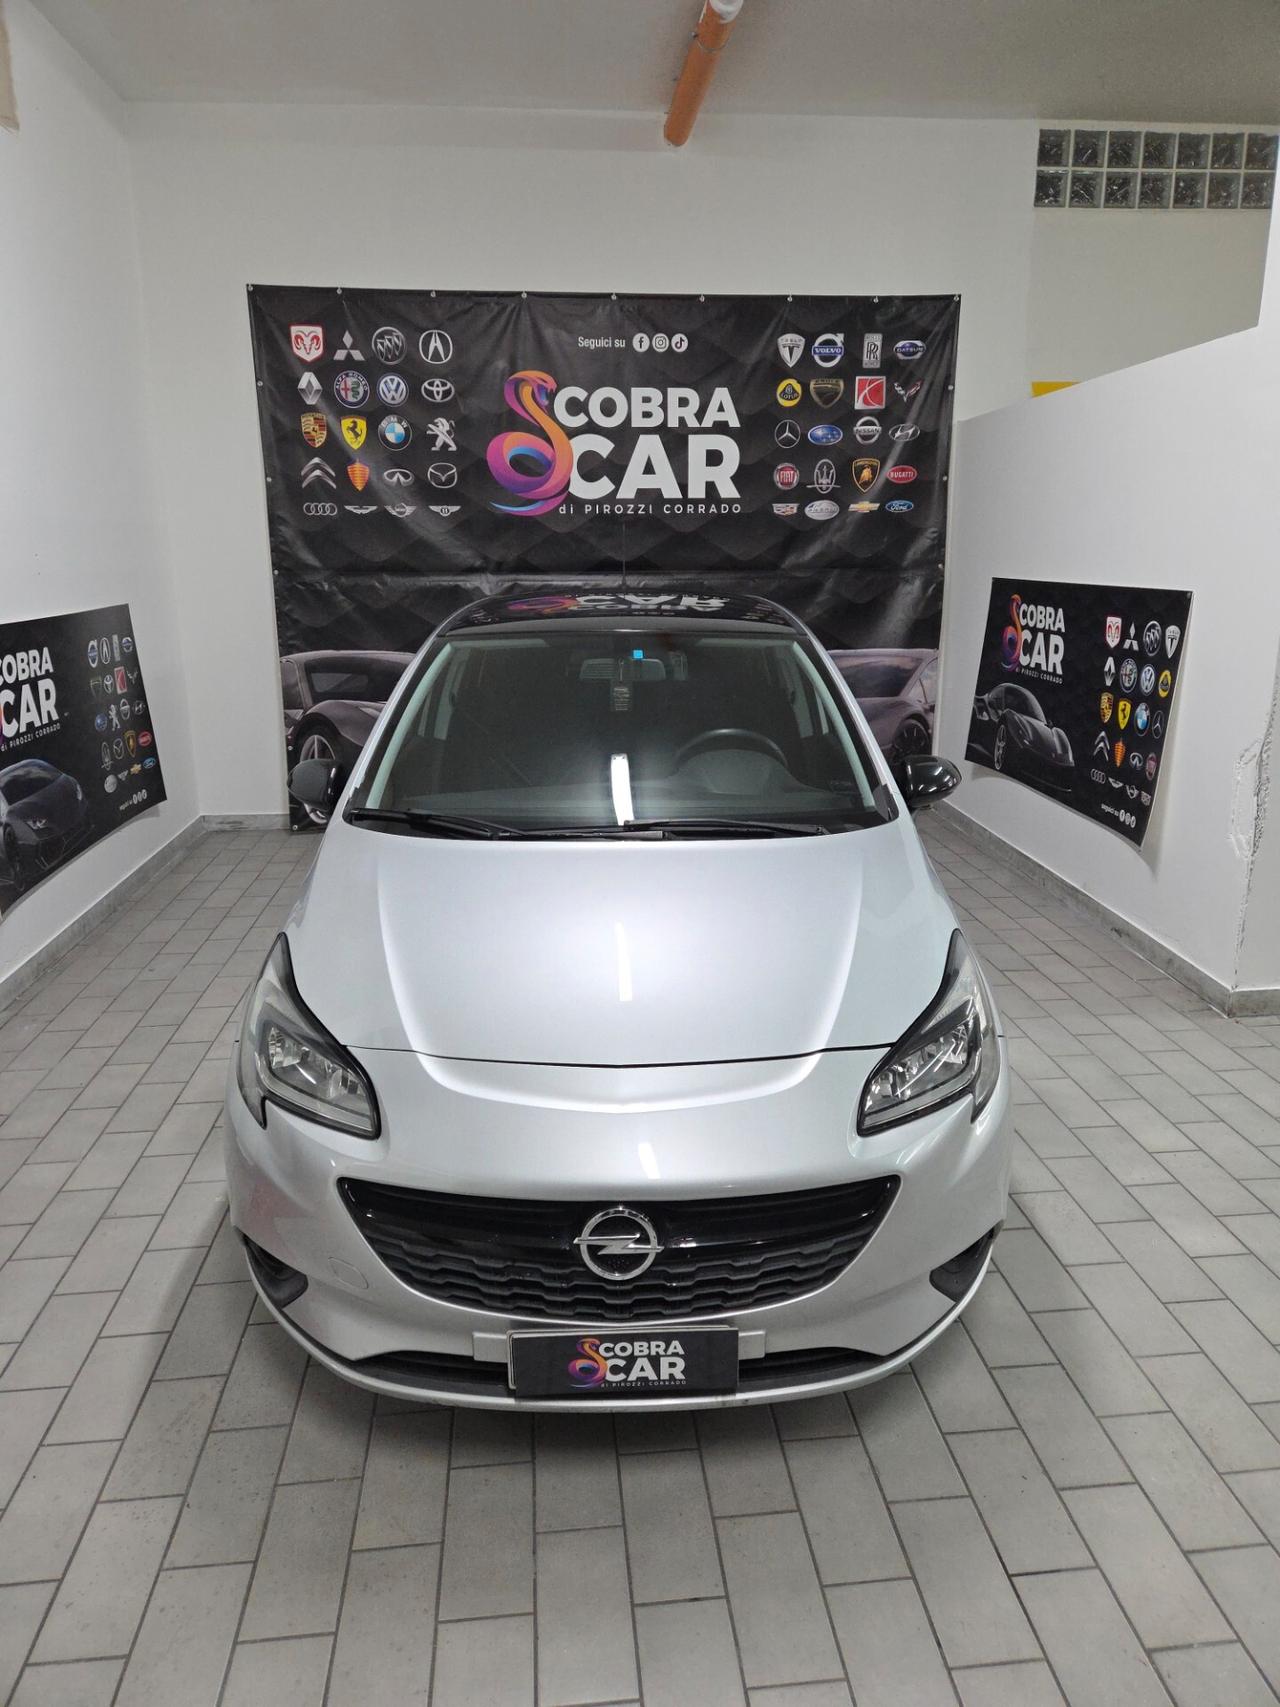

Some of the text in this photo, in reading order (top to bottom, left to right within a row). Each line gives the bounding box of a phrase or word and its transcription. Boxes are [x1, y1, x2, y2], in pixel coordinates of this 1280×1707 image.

[578, 336, 626, 349] Seguici su
[553, 386, 741, 428] COBRA
[568, 433, 741, 500] CAR
[780, 470, 794, 483] FIAT
[558, 503, 742, 514] di PIROZZI CORRADO
[890, 502, 908, 511] Ford
[1019, 603, 1065, 632] COBRA
[1019, 629, 1064, 675] CAR
[0, 678, 59, 737] CAR
[9, 733, 34, 748] PIROZZI
[35, 722, 60, 738] CORRADO
[599, 1340, 685, 1356] COBRA
[605, 1357, 685, 1381] CAR
